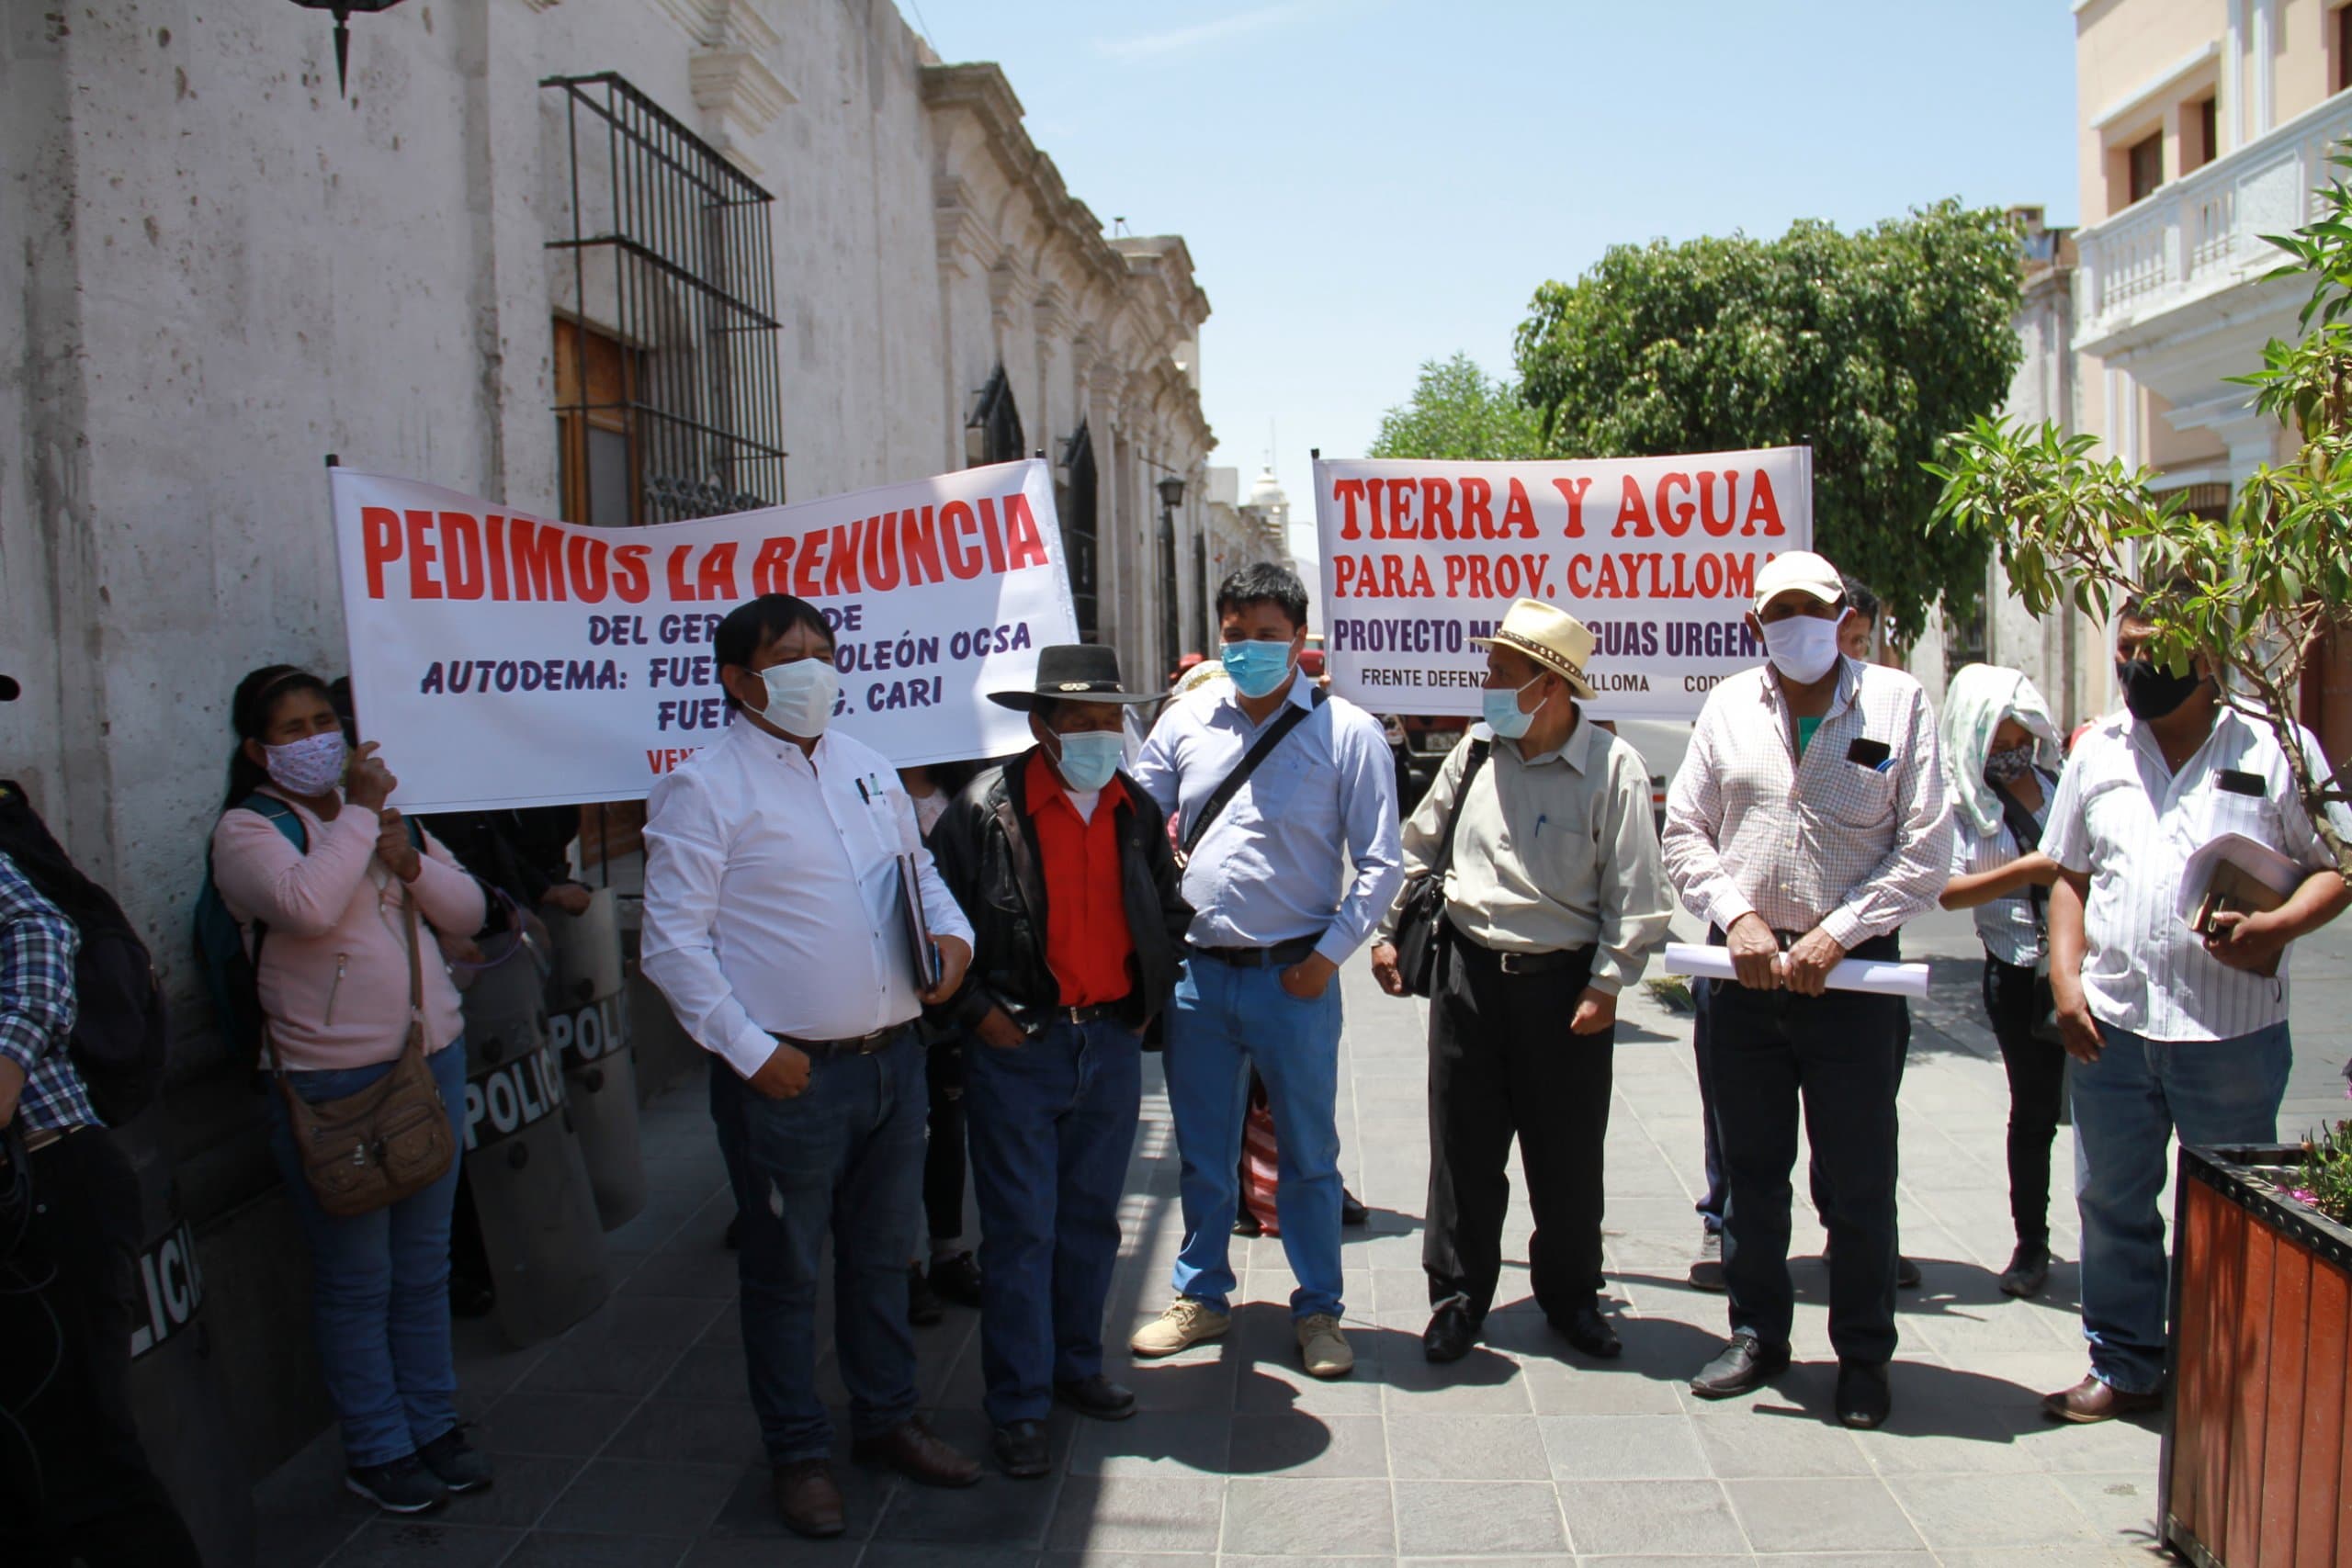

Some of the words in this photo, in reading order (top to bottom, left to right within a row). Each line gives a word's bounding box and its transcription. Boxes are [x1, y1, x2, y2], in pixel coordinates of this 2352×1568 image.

[1333, 477, 1540, 541] TIERRA
[1551, 477, 1593, 538] Y
[1611, 469, 1786, 538] AGUA
[361, 506, 652, 604] PEDIMOS
[667, 542, 739, 602] LA
[752, 492, 1049, 598] RENUNCIA
[1333, 554, 1435, 598] PARA
[1443, 554, 1555, 599] PROV.
[1566, 552, 1775, 599] CAYLLOM
[588, 615, 649, 645] DEL
[820, 604, 862, 632] DE
[1334, 619, 1463, 653] PROYECTO
[1666, 621, 1770, 658] URGEN
[421, 659, 628, 695] AUTODEMA:
[649, 656, 722, 688] FUE
[835, 629, 940, 674] OLEÓN
[950, 622, 1031, 660] OCSA
[1362, 669, 1422, 687] FRENTE
[1428, 671, 1488, 688] DEFENZ
[1582, 674, 1650, 692] YLLOMA
[658, 698, 736, 731] FUER
[866, 675, 942, 713] CARI
